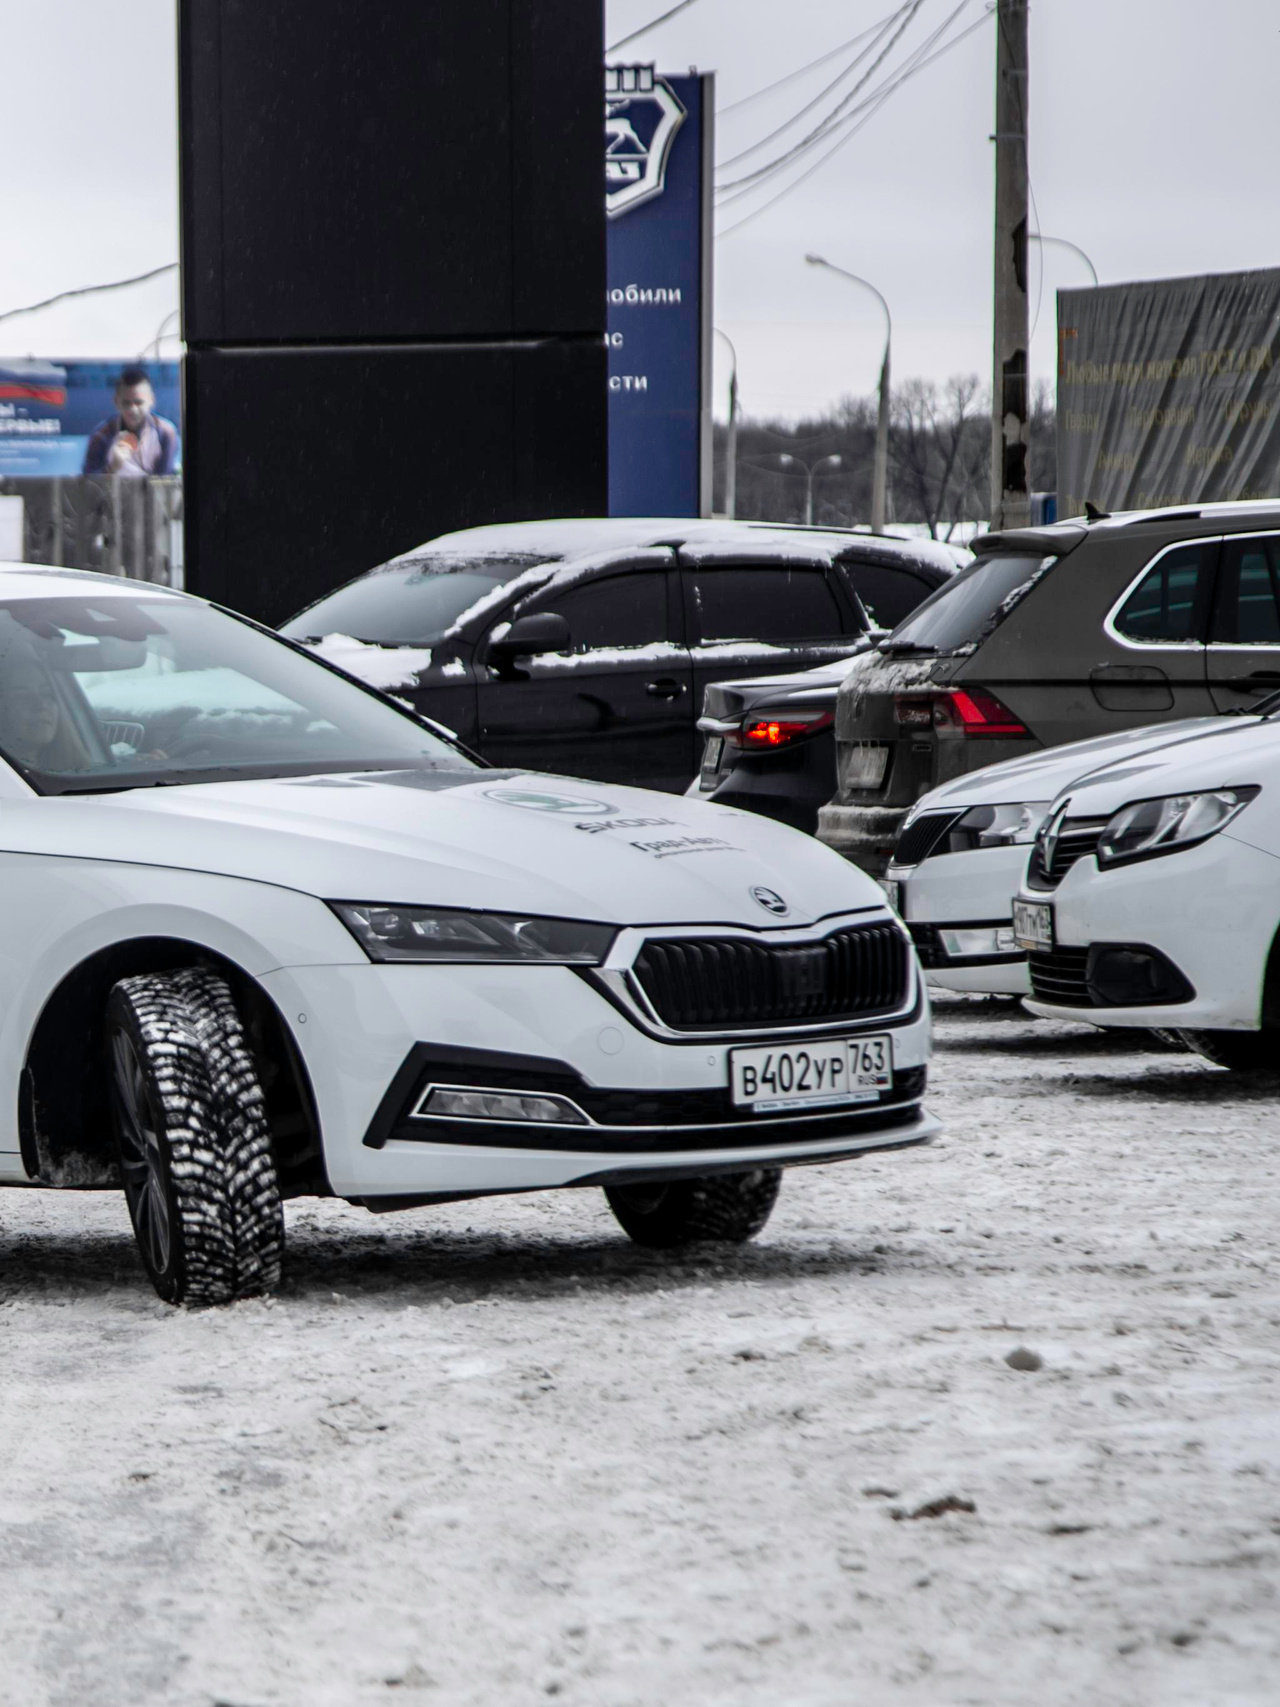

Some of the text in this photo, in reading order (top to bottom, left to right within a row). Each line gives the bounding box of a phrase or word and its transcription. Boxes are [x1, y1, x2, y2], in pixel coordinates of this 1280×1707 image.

[742, 1041, 884, 1096] В402УР 763
[857, 1074, 877, 1086] RUS
